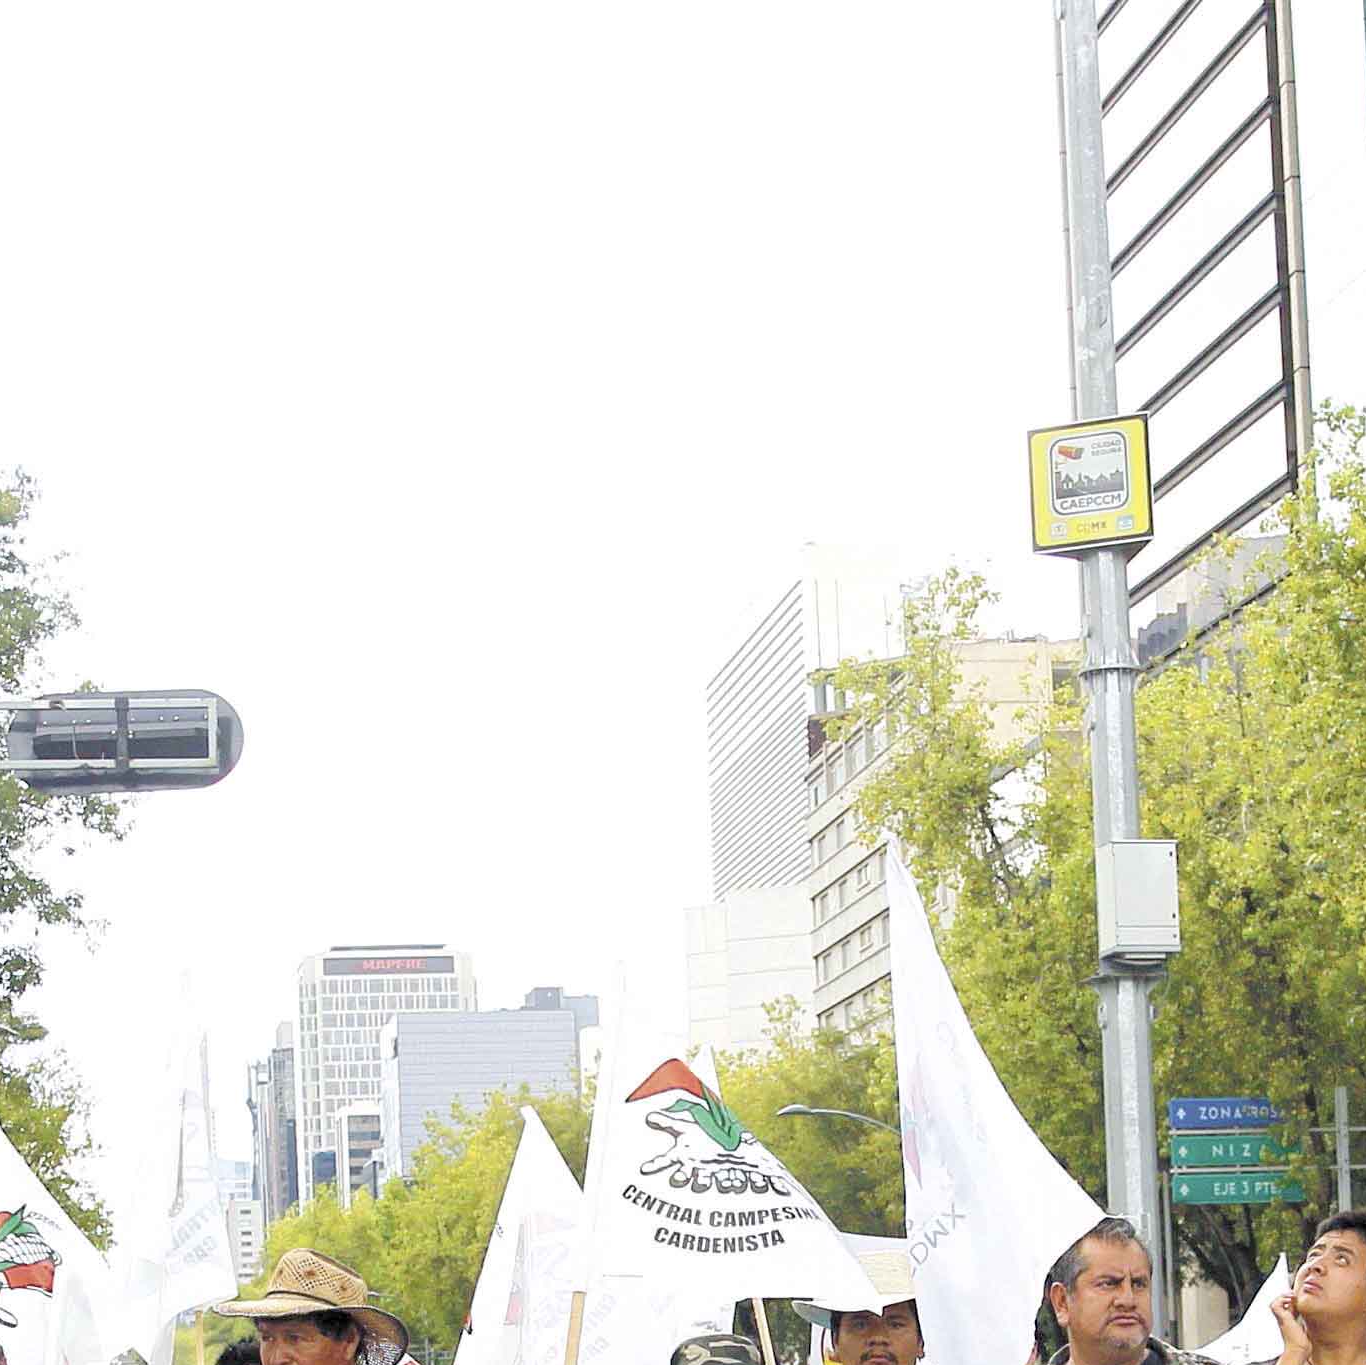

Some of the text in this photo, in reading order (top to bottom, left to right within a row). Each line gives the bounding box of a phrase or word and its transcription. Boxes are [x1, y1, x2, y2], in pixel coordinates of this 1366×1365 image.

[1059, 493, 1123, 511] CAEPCCM
[1198, 1104, 1283, 1120] ZONA ROS
[1213, 1182, 1236, 1196] EJE
[1241, 1181, 1249, 1195] 3
[621, 1183, 703, 1226] CENTRAL
[653, 1226, 785, 1254] CARDENISTA
